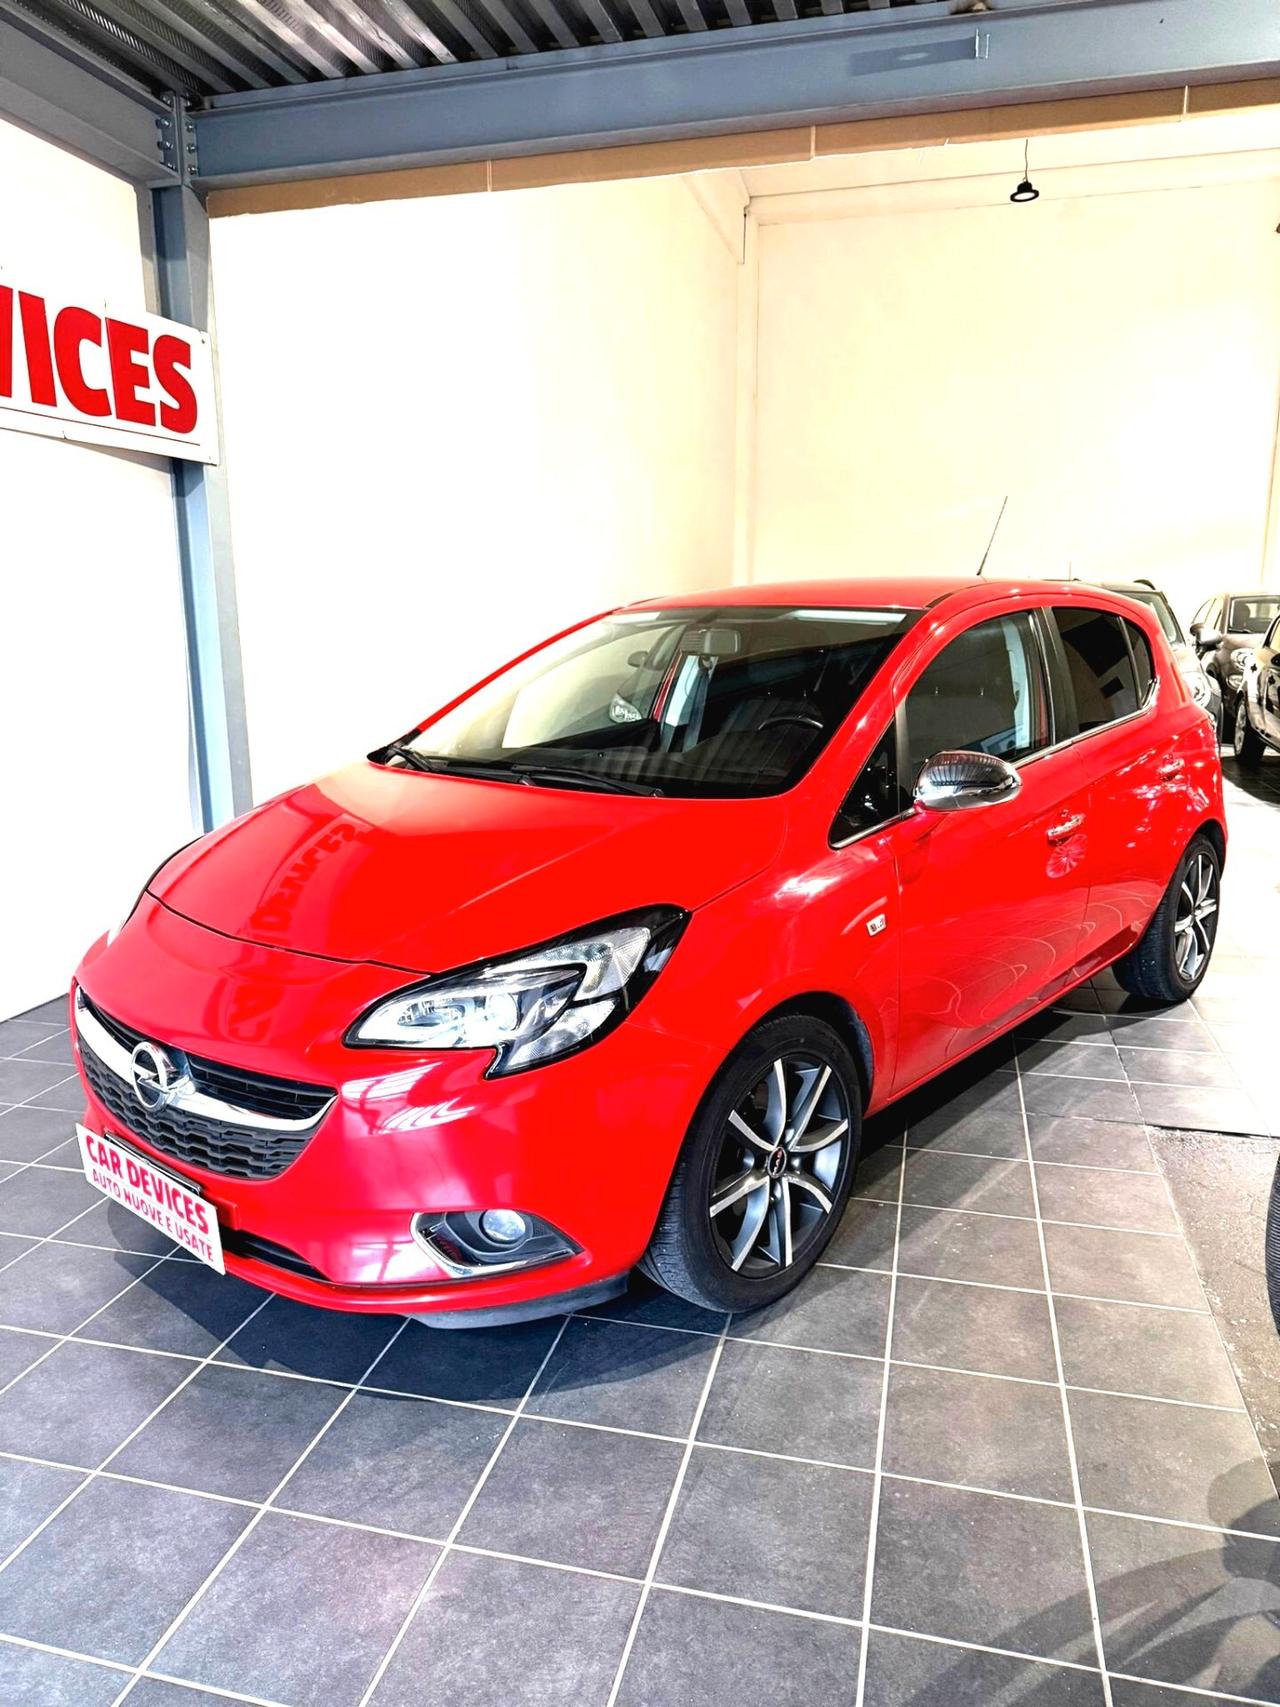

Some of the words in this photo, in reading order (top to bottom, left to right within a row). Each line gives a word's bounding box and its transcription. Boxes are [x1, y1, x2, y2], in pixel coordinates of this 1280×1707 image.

[86, 1135, 123, 1179] CAR
[126, 1158, 209, 1235] DEVICES
[92, 1168, 121, 1199] AUTO
[123, 1187, 164, 1226] NUOVE
[166, 1215, 173, 1234] E
[175, 1221, 214, 1264] USATE
